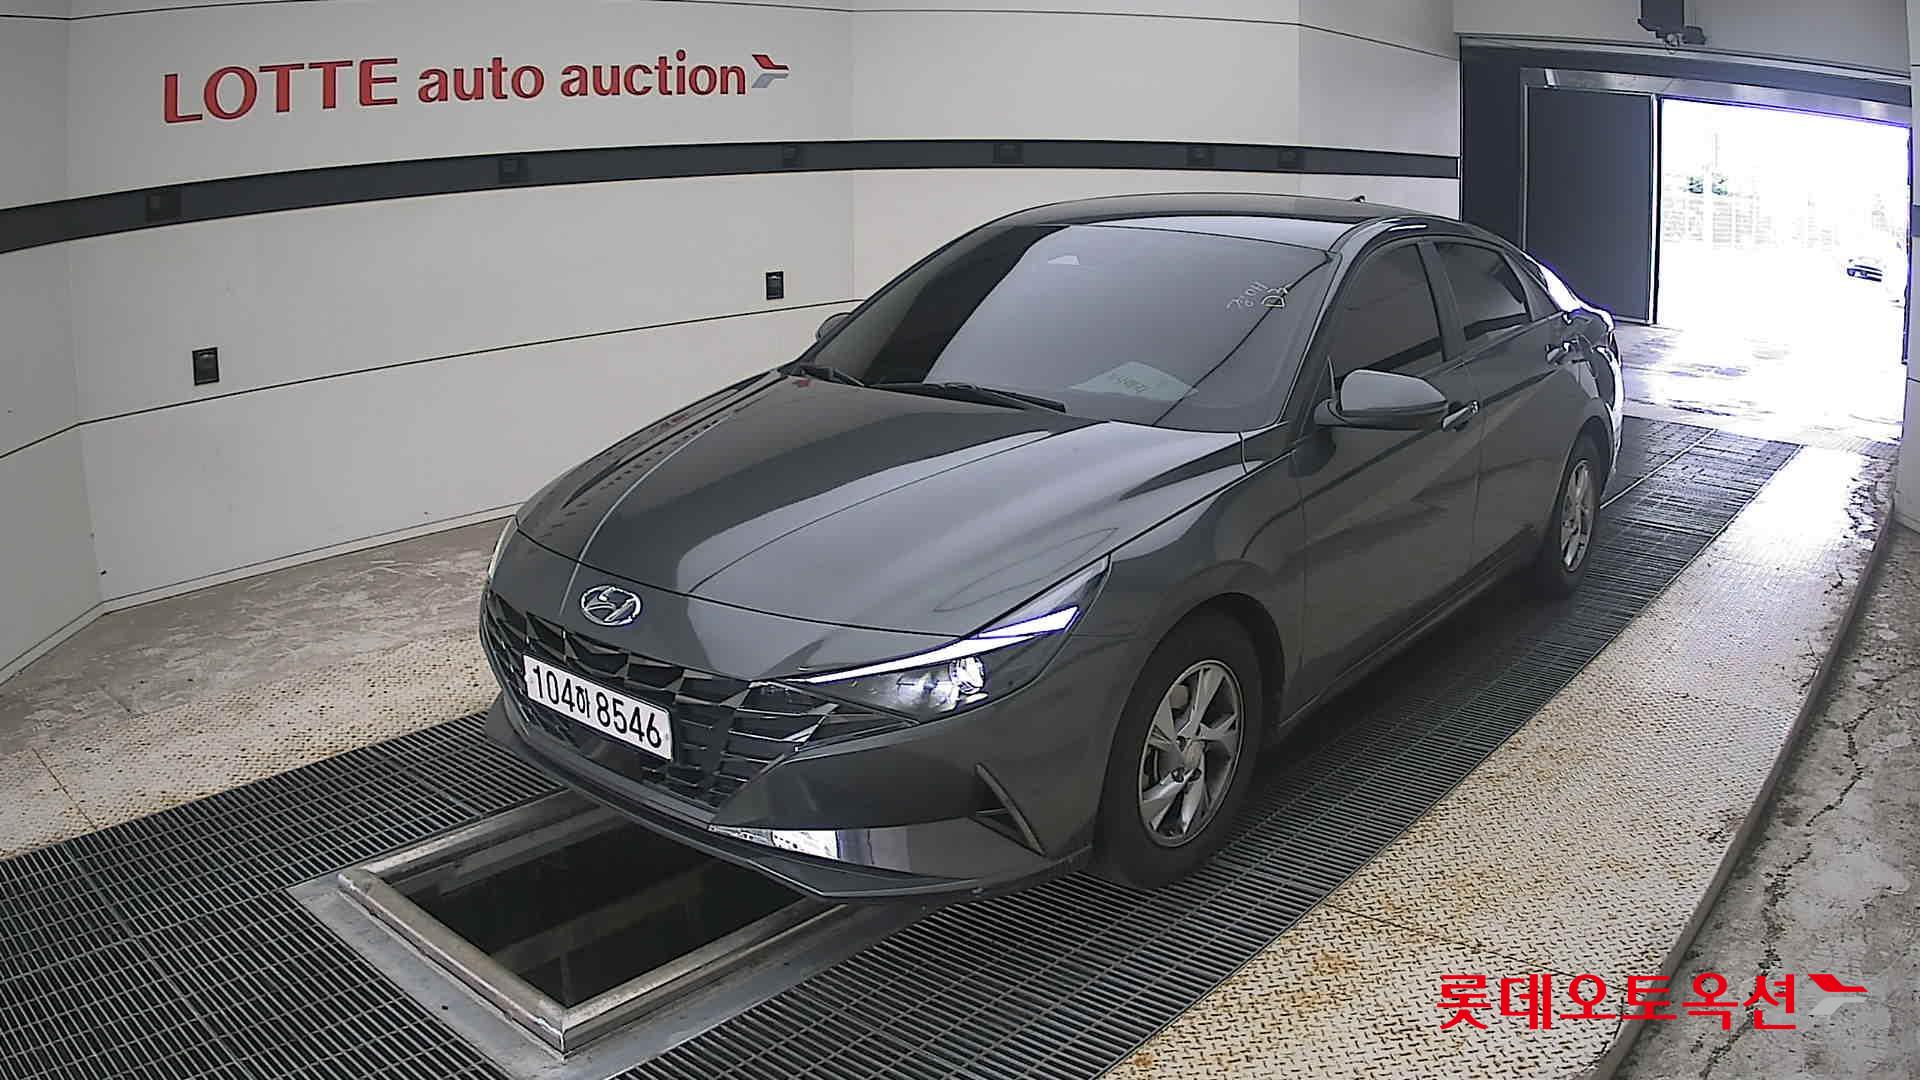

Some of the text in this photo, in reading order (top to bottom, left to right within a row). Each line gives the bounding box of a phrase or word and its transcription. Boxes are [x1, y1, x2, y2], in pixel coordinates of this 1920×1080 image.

[163, 49, 748, 124] LOTTE auto auction
[595, 691, 663, 750] 8546
